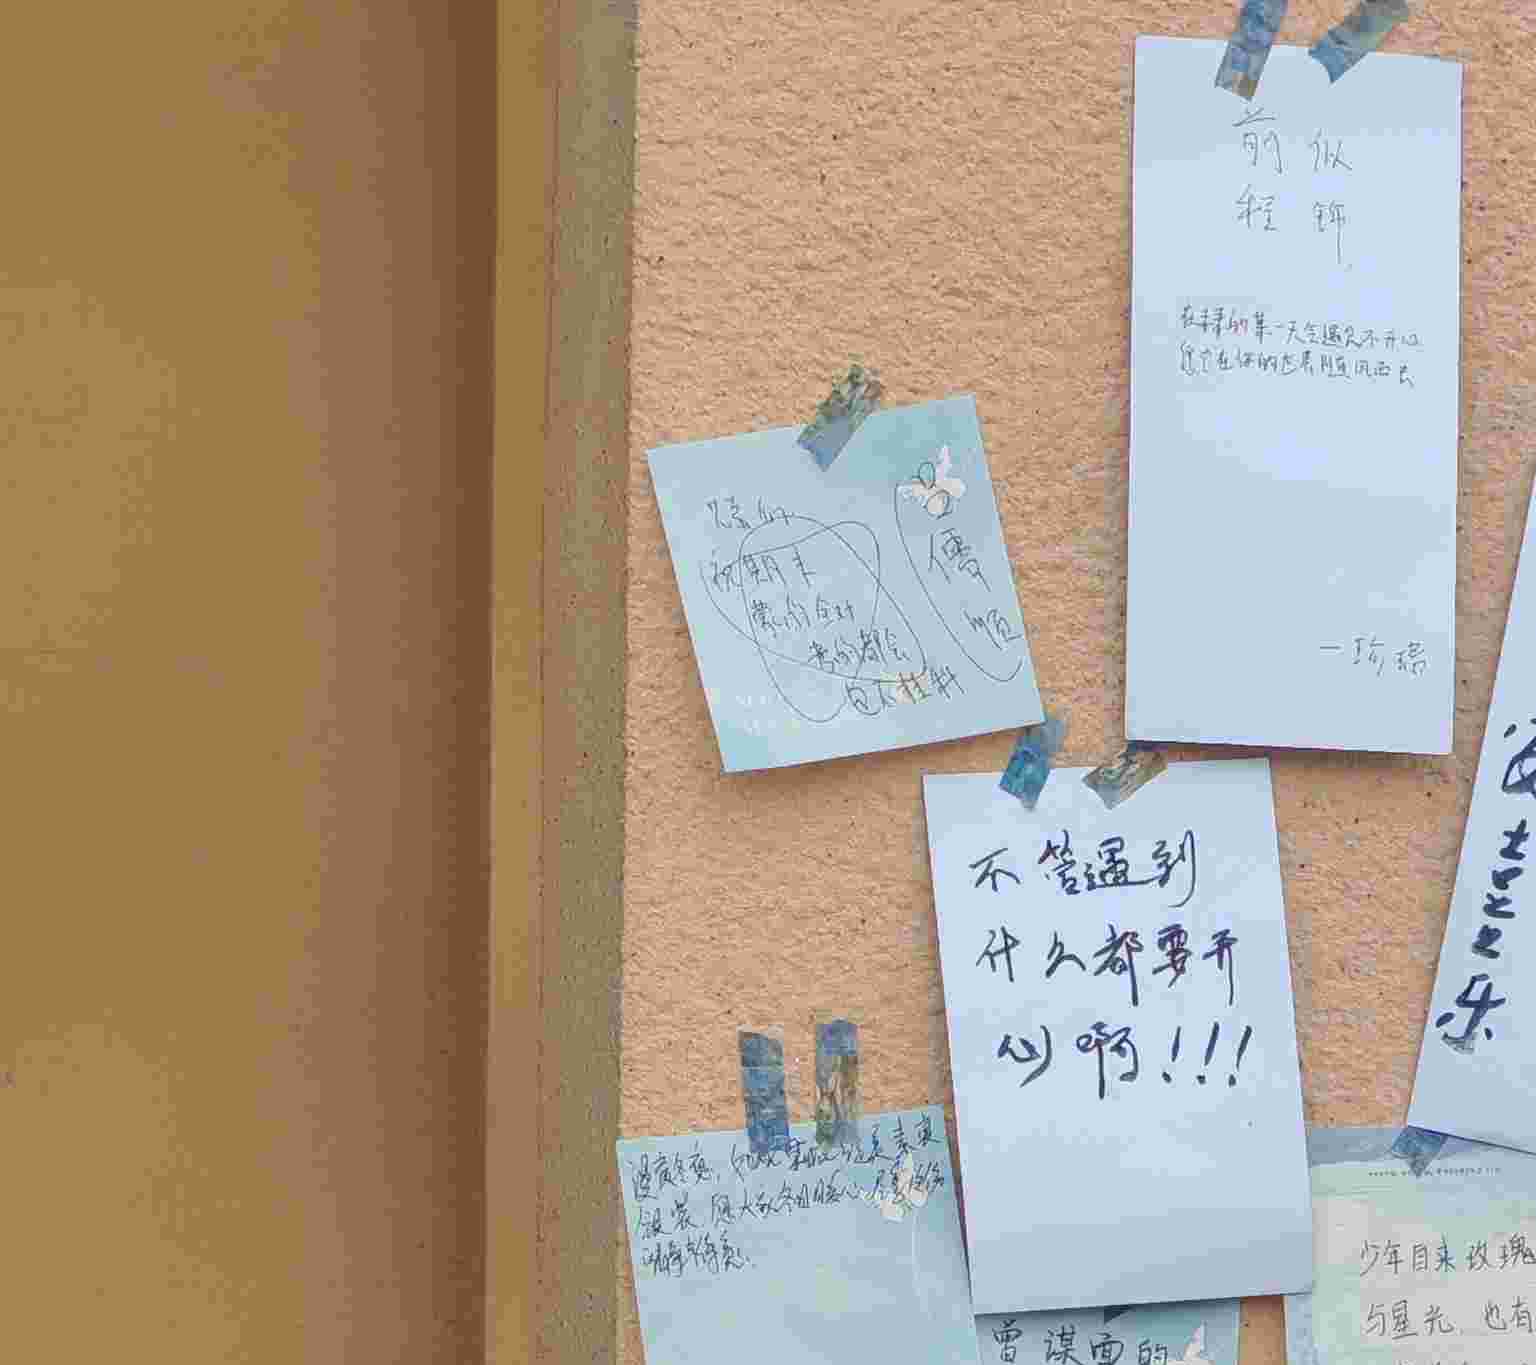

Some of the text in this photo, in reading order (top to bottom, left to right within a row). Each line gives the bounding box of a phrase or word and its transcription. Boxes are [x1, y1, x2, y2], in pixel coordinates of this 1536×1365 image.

[968, 829, 1198, 908] 不管遇到
[975, 922, 1240, 1006] 什么都要开
